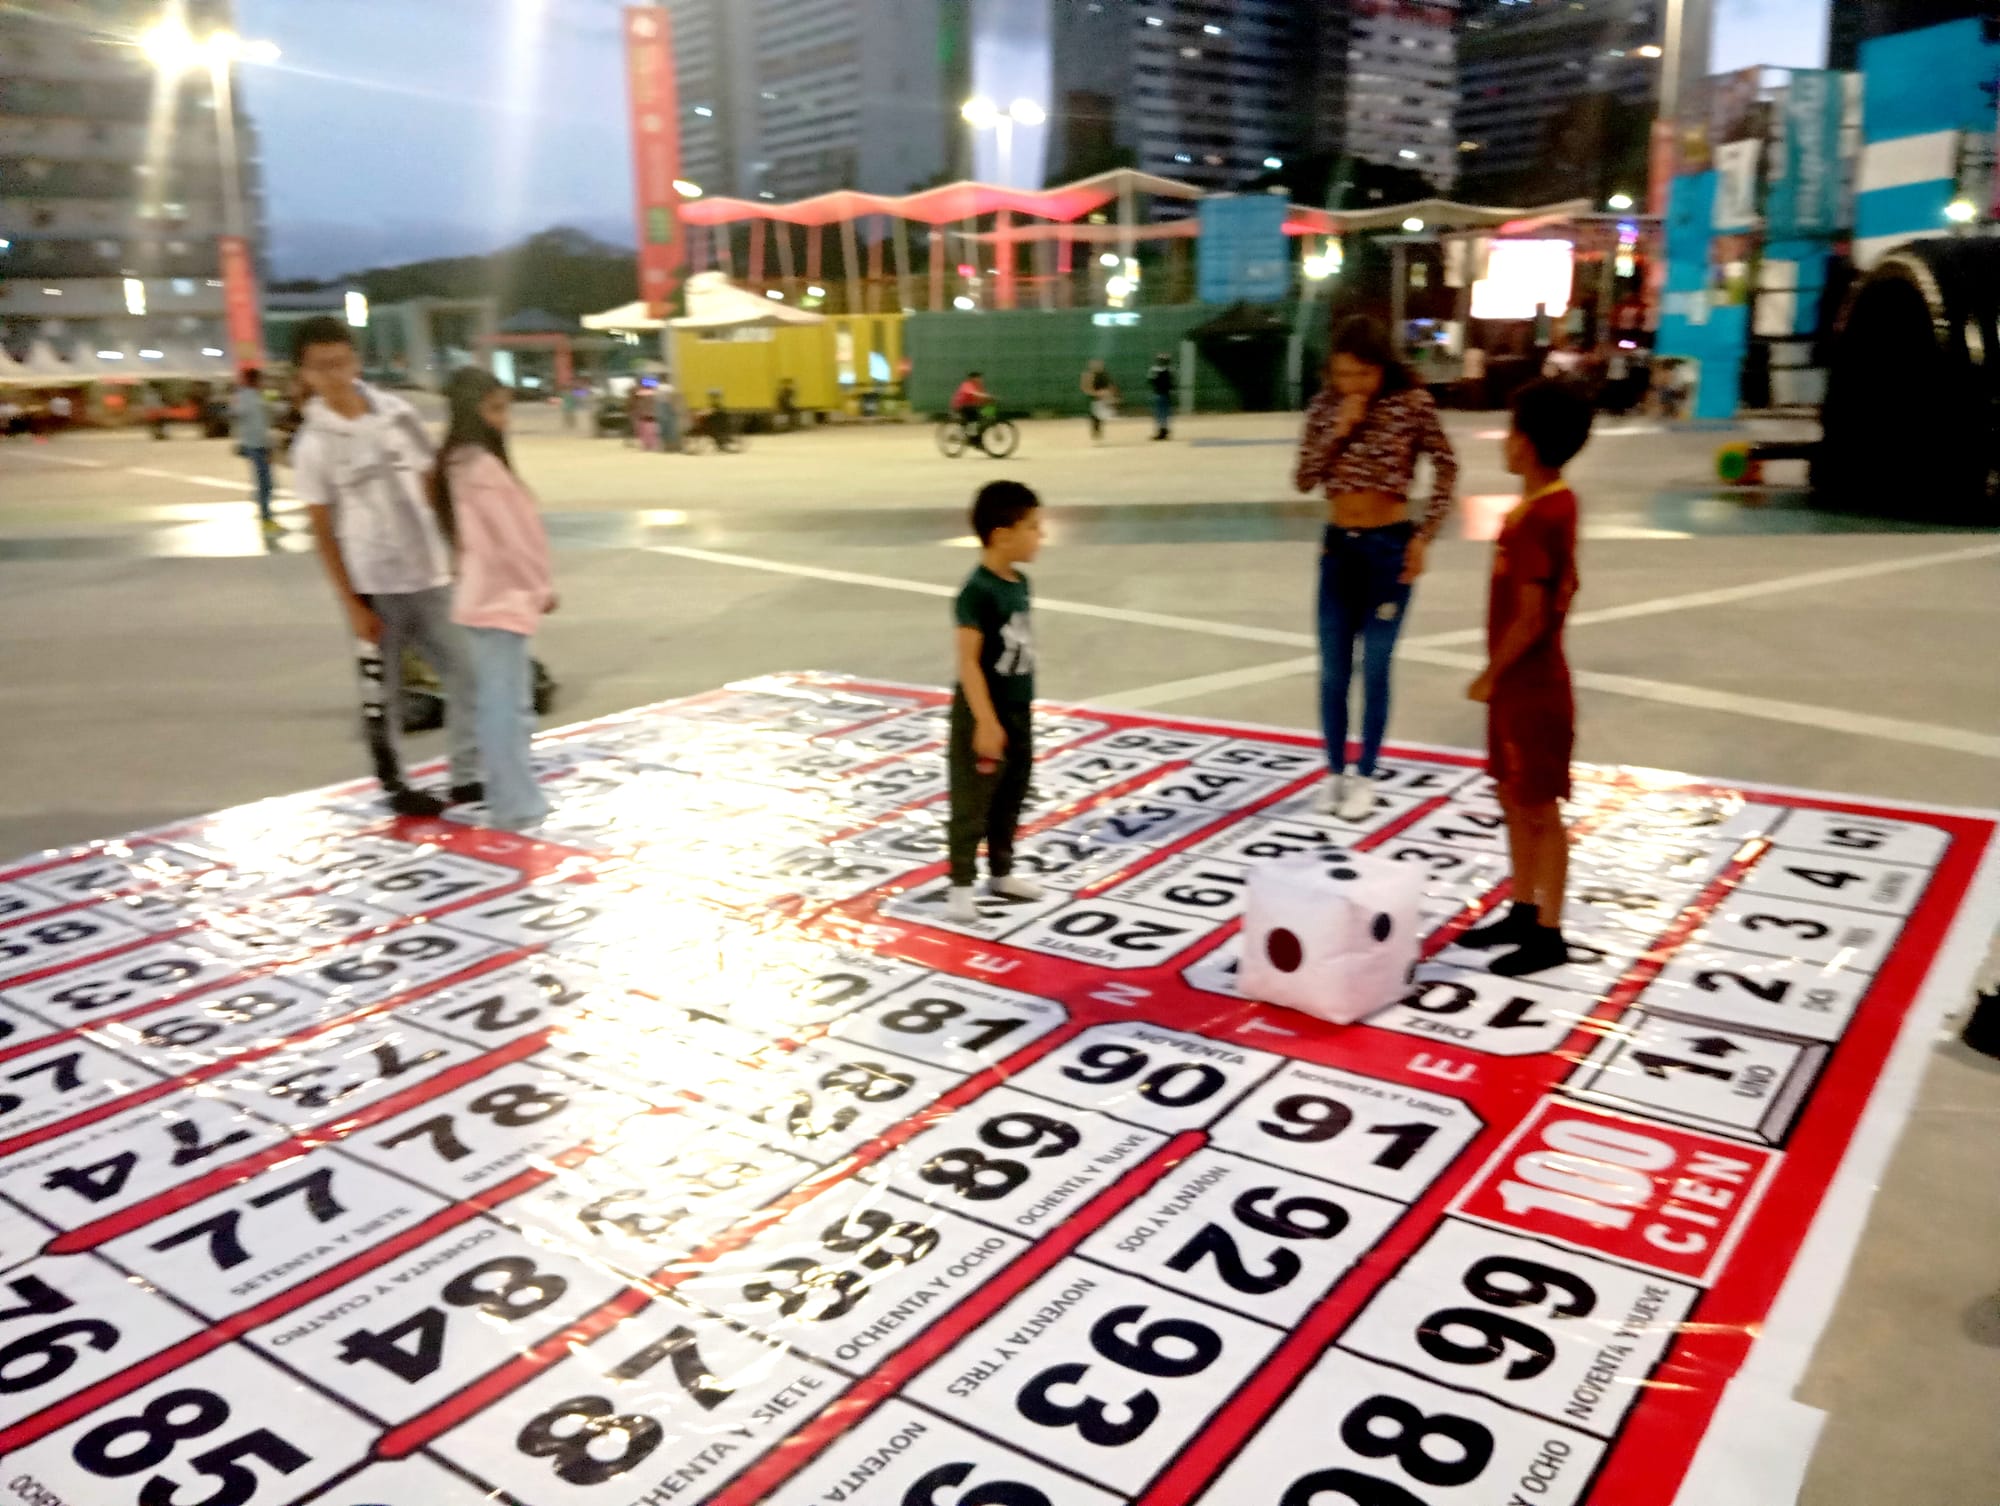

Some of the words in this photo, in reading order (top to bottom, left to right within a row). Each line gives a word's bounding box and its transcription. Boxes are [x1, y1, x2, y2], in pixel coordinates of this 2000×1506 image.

[1103, 734, 1202, 757] 26
[1217, 748, 1316, 773] 25
[1160, 771, 1244, 803] 24
[1822, 827, 1891, 850] 5
[377, 868, 486, 903] 61
[1162, 870, 1248, 908] 19
[1783, 864, 1866, 890] 4
[1052, 909, 1194, 952] 20
[1740, 912, 1833, 941] 3
[50, 959, 203, 1011] 63
[319, 935, 458, 983] 69
[1401, 979, 1549, 1031] 10
[1693, 969, 1794, 1004] 2
[878, 997, 1031, 1053] 81
[1128, 1028, 1244, 1064] NOVENTA
[1402, 1014, 1476, 1041] DIEZ
[1059, 1043, 1227, 1108] 90
[1629, 1050, 1734, 1082] 1
[1732, 1064, 1777, 1099] UNO
[375, 1083, 571, 1163] 78
[1257, 1092, 1440, 1171] 91
[41, 1117, 254, 1203] 74
[918, 1111, 1082, 1201] 89
[1016, 1176, 1093, 1225] OCHENTA
[1083, 1165, 1102, 1173] Y
[1094, 1135, 1147, 1164] NUEVE
[1498, 1118, 1678, 1232] 100
[1157, 1167, 1230, 1215] NOVENTA
[1643, 1150, 1753, 1255] CIEN
[147, 1166, 348, 1271] 77
[1116, 1226, 1157, 1252] DOS
[1148, 1218, 1168, 1227] Y
[1163, 1186, 1351, 1295] 92
[230, 1246, 334, 1295] SETENTA
[335, 1255, 568, 1385] 84
[836, 1291, 939, 1360] OCHENTA
[928, 1277, 950, 1288] Y
[947, 1238, 1006, 1277] OCHO
[1006, 1279, 1097, 1344] NOVENTA
[1415, 1254, 1598, 1381] 99
[947, 1361, 1003, 1397] TRES
[995, 1348, 1018, 1360] Y
[1016, 1304, 1224, 1447] 93
[516, 1324, 737, 1486] 87
[729, 1428, 754, 1438] Y
[752, 1376, 822, 1424] SIETE
[1564, 1346, 1633, 1420] NOVENTA
[71, 1387, 313, 1506] 85
[822, 1422, 927, 1502] NOVENTA
[1521, 1440, 1570, 1494] OCHO
